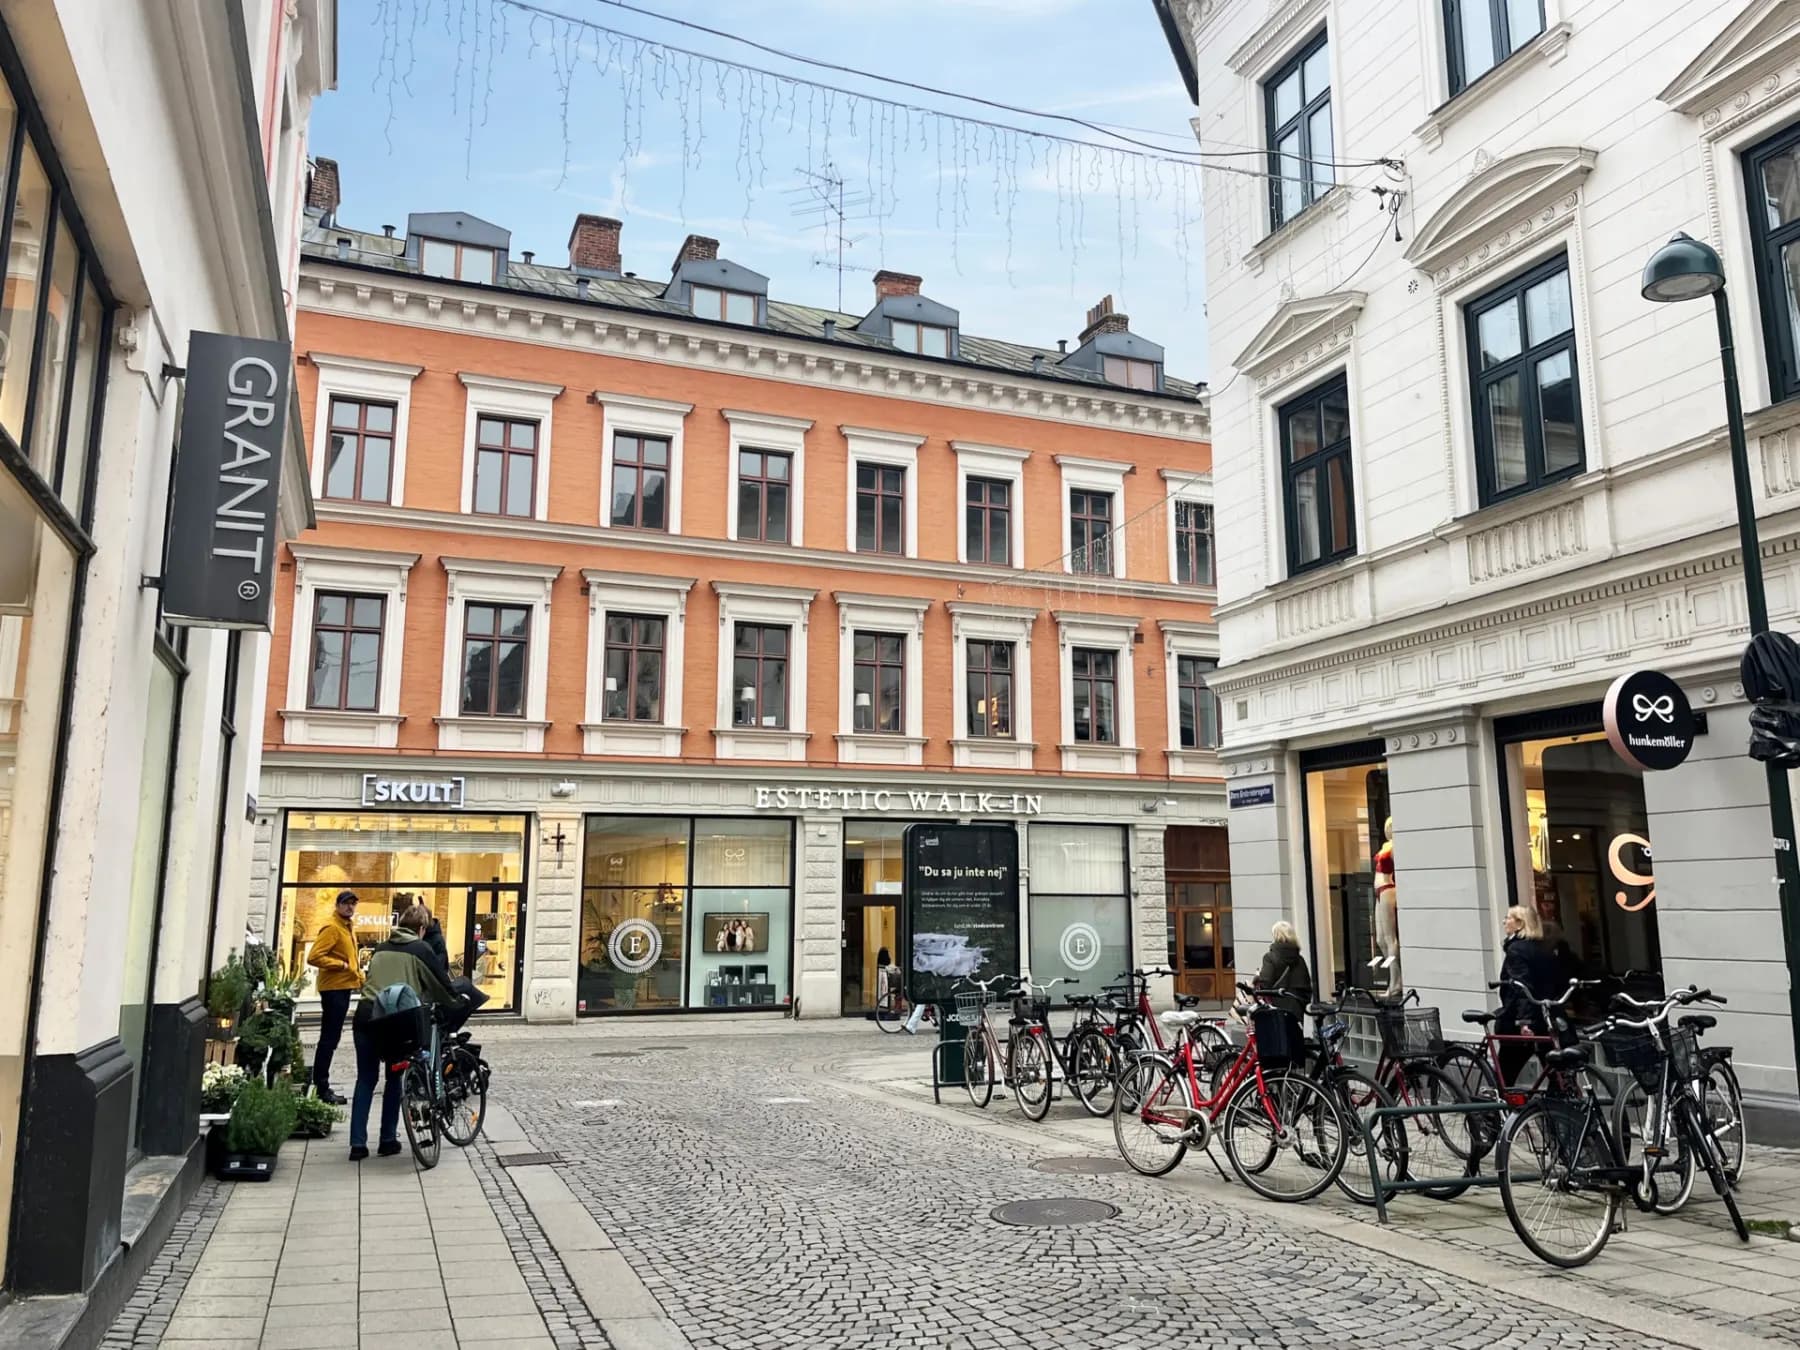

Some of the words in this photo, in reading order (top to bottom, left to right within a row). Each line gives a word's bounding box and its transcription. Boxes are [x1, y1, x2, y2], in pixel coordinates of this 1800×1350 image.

[213, 357, 278, 573] GRANIT
[1628, 733, 1686, 748] hunkemöller
[755, 786, 891, 811] ESTETIC
[908, 790, 1042, 815] WALK-IN
[941, 868, 952, 877] sa
[953, 866, 963, 880] ju
[965, 866, 985, 877] inte
